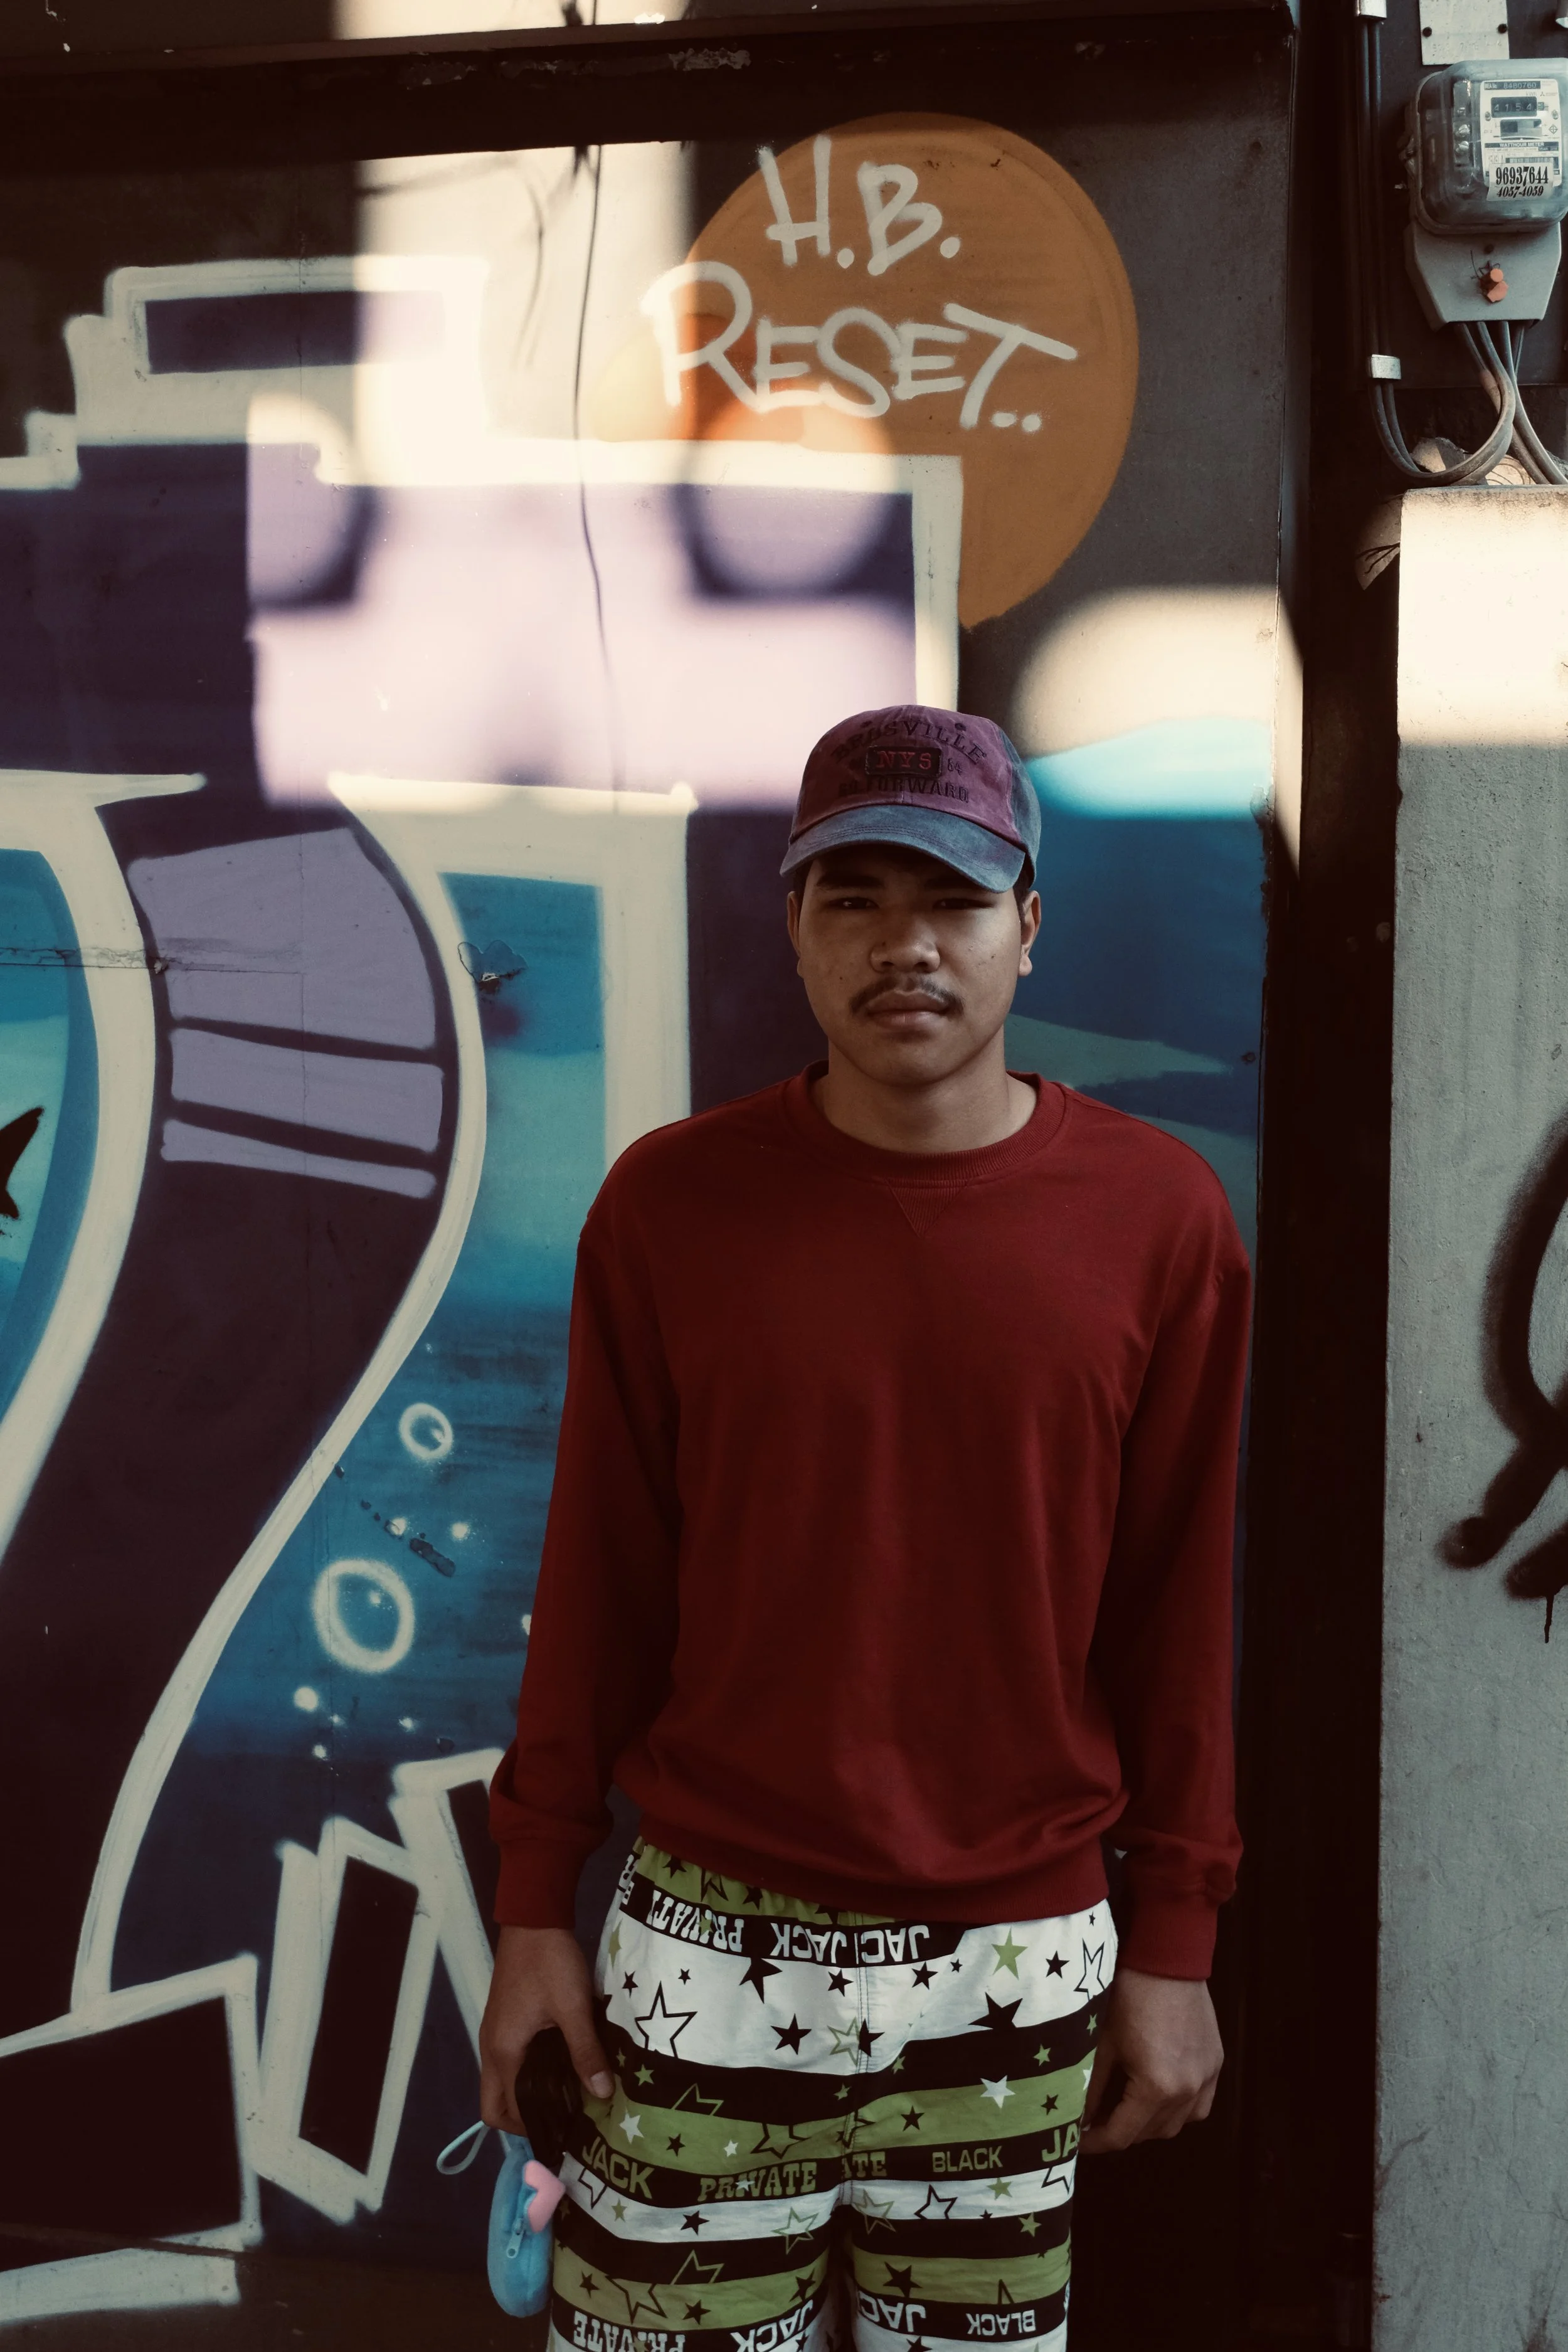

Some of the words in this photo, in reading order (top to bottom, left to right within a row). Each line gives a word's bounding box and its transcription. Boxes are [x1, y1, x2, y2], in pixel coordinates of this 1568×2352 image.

[1496, 166, 1549, 186] 96937644
[1496, 185, 1544, 199] 4057-4059
[757, 134, 961, 275] H.B.
[876, 750, 932, 771] NYS
[771, 1922, 847, 1963] JACK
[854, 1924, 930, 1964] JAC
[581, 2136, 654, 2200] JACK
[697, 2161, 817, 2201] PRIVATE
[932, 2146, 1004, 2173] BLACK
[729, 2299, 813, 2352] JACK
[966, 2309, 1037, 2336] BLACK
